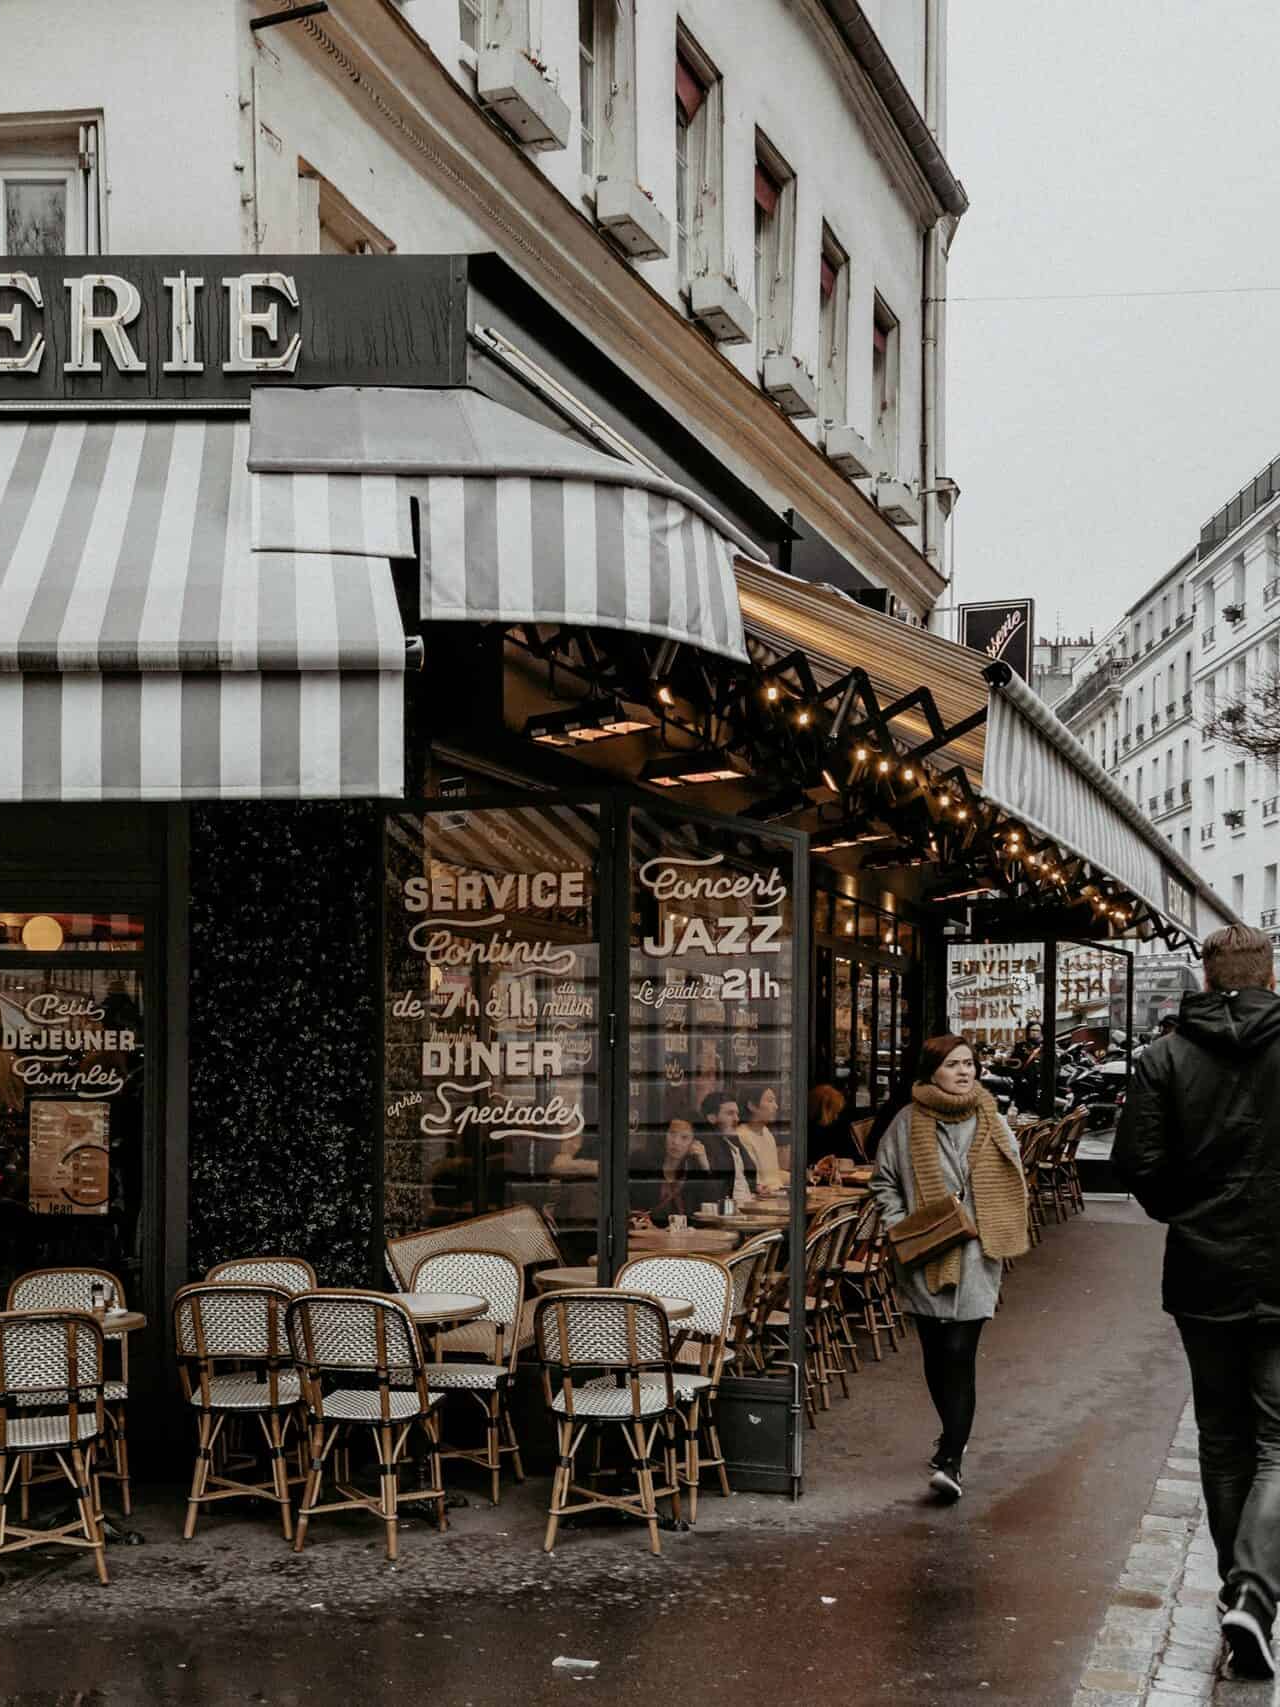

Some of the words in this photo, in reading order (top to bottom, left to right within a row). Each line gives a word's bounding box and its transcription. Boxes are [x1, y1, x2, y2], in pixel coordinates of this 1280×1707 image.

[404, 871, 585, 913] SERVICE
[639, 853, 787, 908] Concert
[408, 913, 577, 977] Continu
[643, 916, 783, 957] JAZZ
[24, 993, 105, 1025] Petit
[392, 990, 425, 1020] de
[633, 979, 655, 1007] Le
[655, 980, 699, 1009] jeudi
[721, 967, 781, 1000] 21h
[12, 1054, 125, 1097] Complet
[422, 1041, 562, 1076] DINER
[420, 1080, 585, 1140] Spectacles
